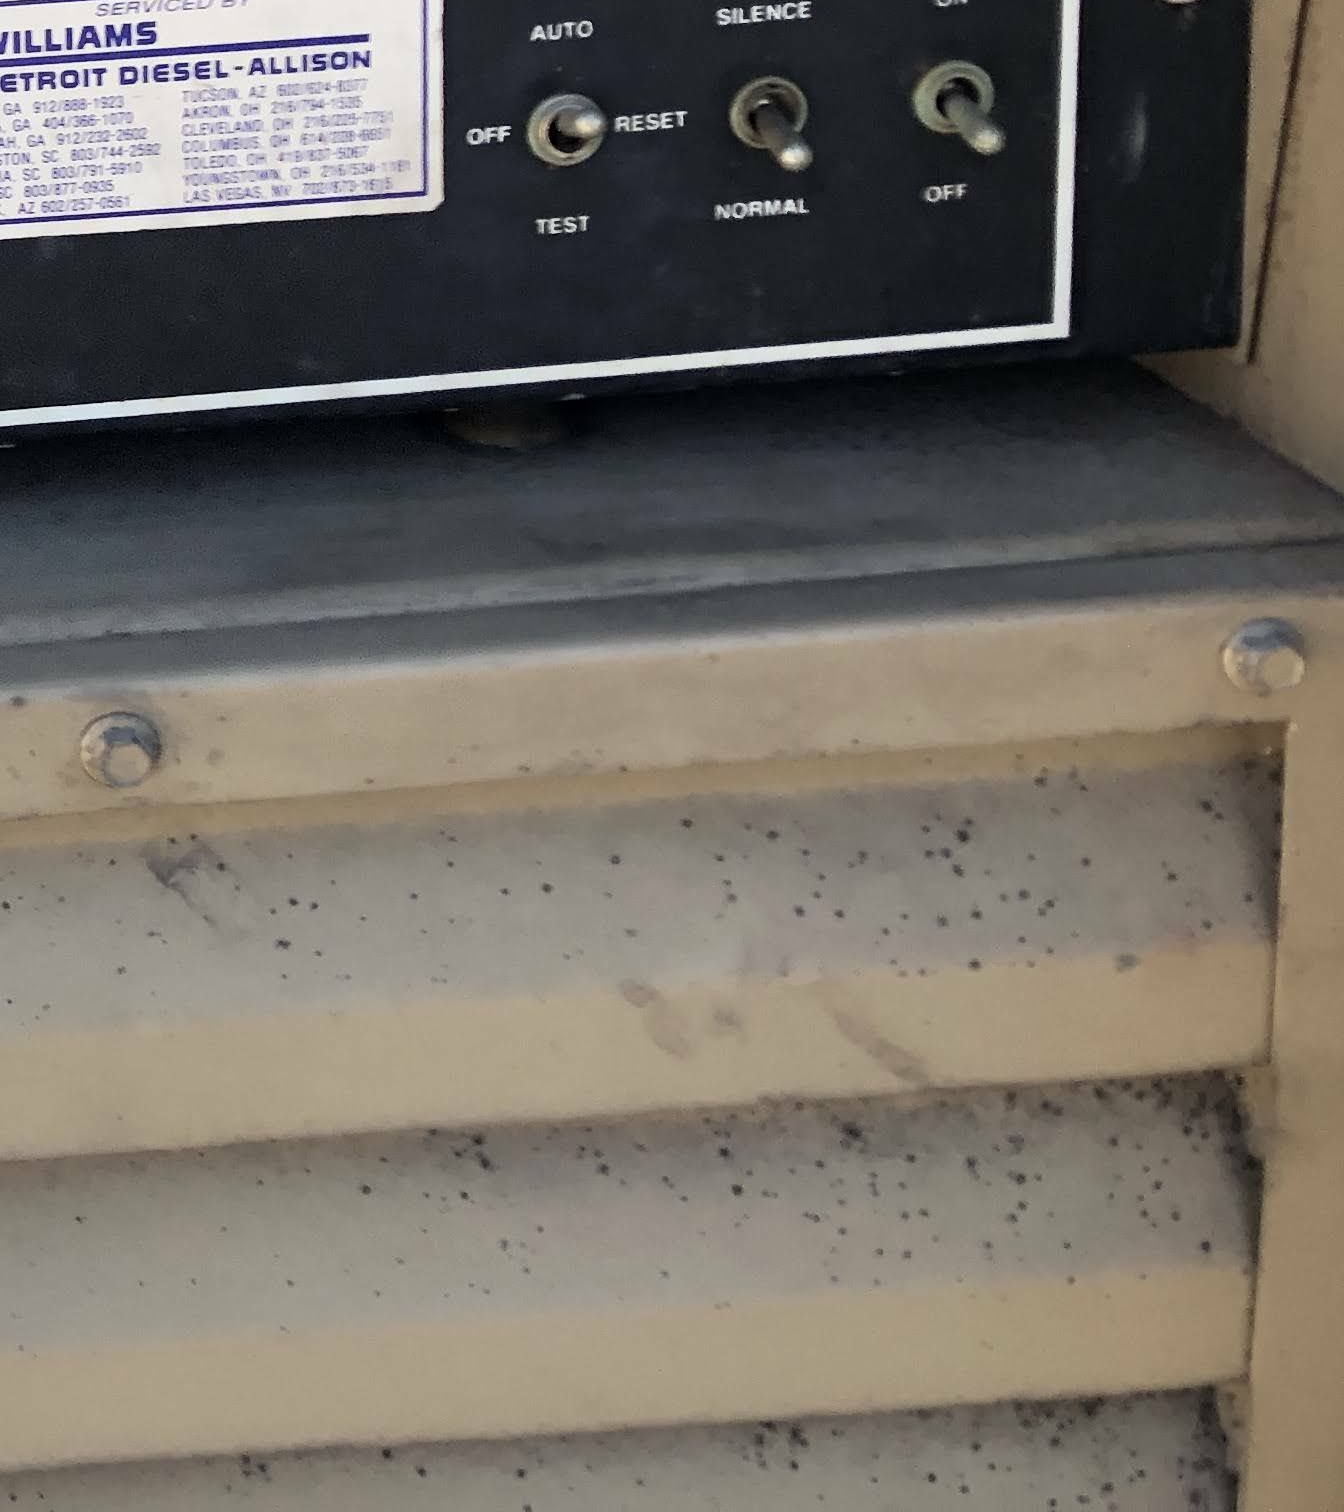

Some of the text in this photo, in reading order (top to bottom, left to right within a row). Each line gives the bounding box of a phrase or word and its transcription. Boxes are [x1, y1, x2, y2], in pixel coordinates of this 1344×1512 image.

[716, 1, 812, 26] SILENCE
[530, 21, 594, 41] AUTO
[3, 103, 22, 115] GA
[13, 119, 31, 132] GA
[615, 110, 688, 133] RESET
[466, 126, 511, 146] OFF
[924, 184, 968, 203] OFF
[715, 197, 810, 220] NORMAL
[536, 216, 589, 235] TEST
